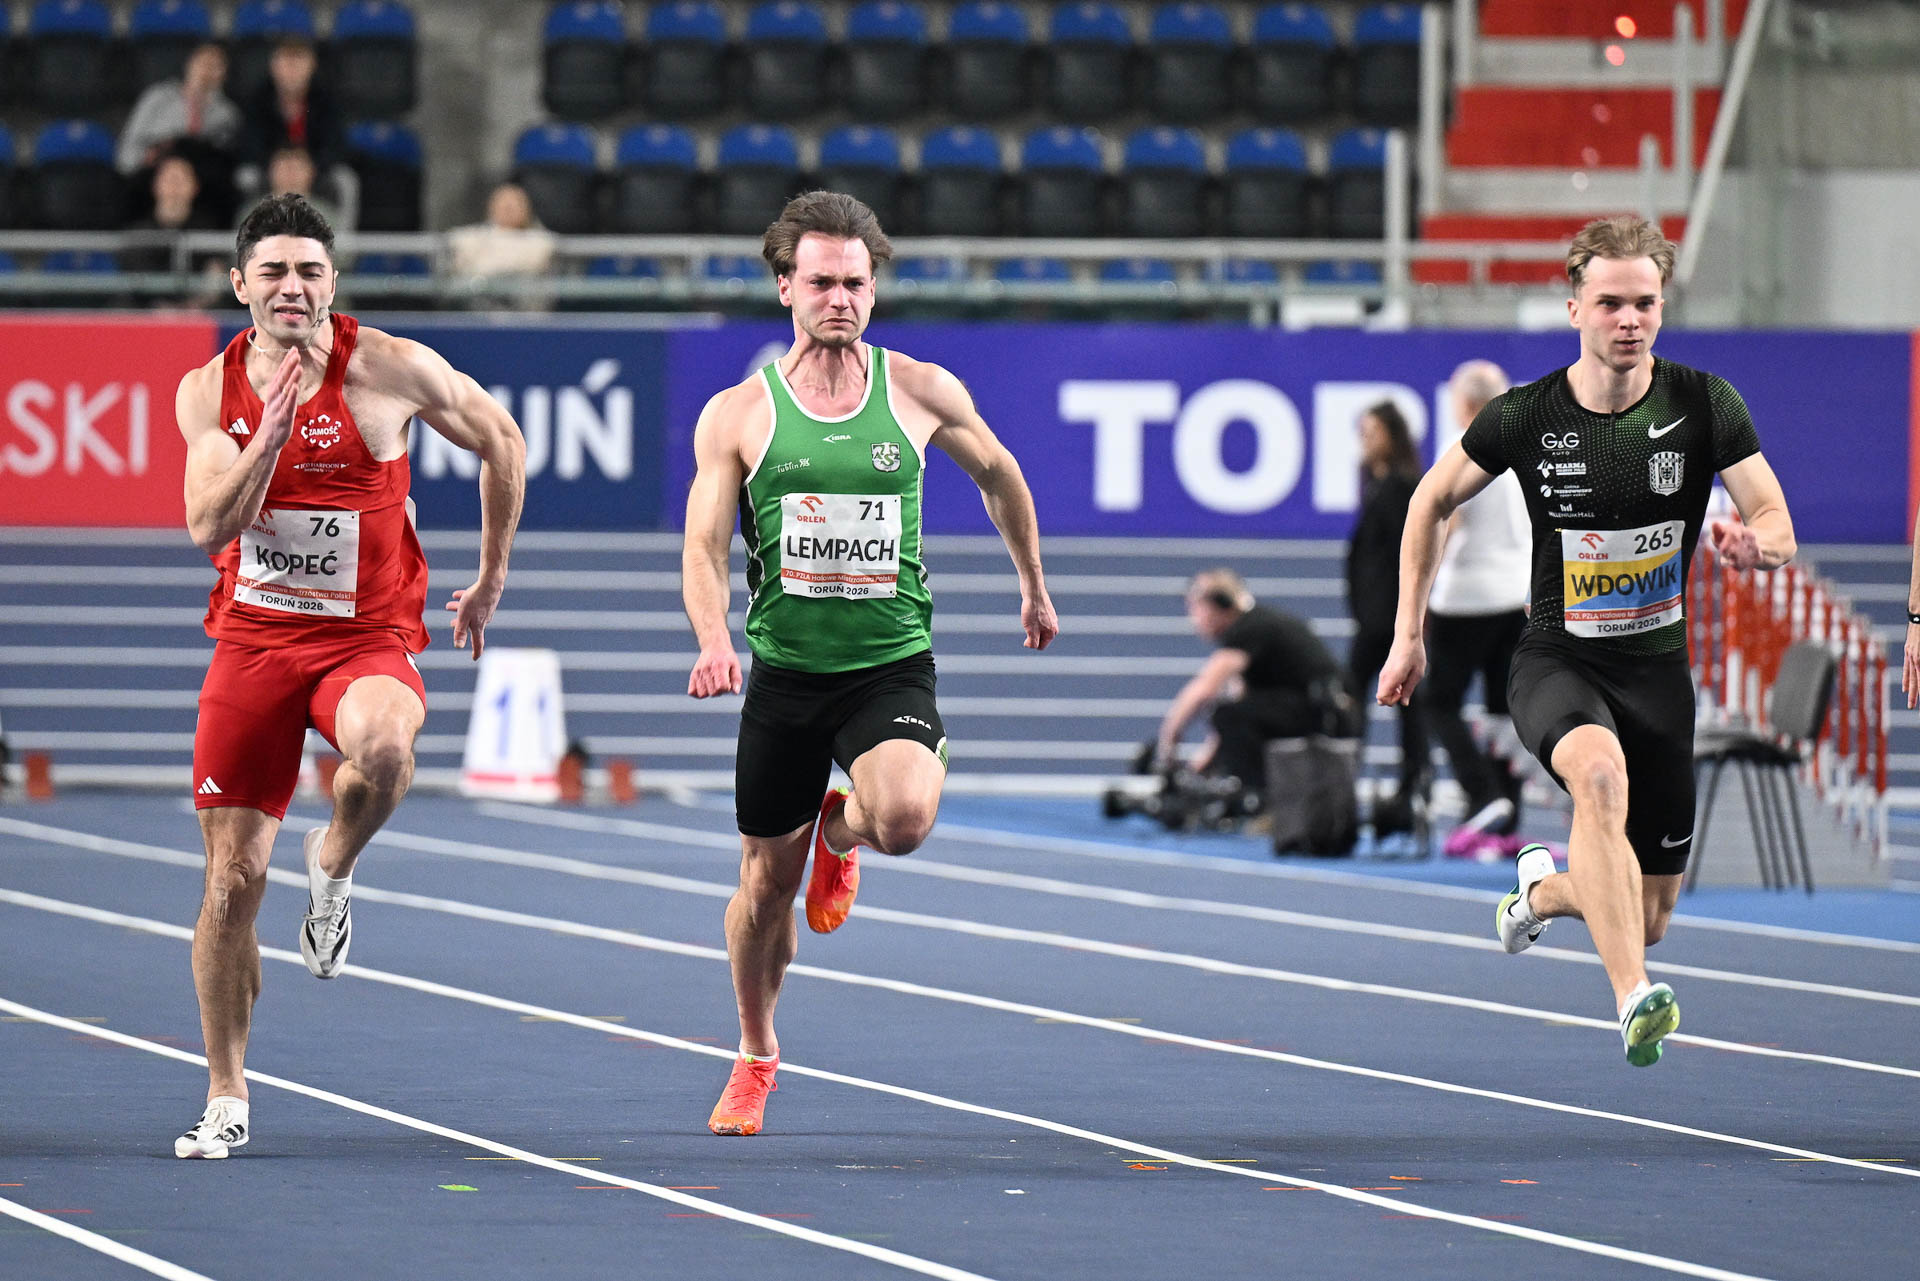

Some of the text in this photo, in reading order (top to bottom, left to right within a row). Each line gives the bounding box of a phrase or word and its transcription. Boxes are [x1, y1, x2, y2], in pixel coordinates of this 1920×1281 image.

[1, 378, 150, 477] SKI
[309, 425, 339, 436] ZAMOŚĆ
[1058, 377, 1465, 515] TOR
[1541, 432, 1580, 449] G&G
[797, 514, 826, 523] ORLEN
[859, 501, 885, 521] 71
[251, 524, 276, 537] ORLEN
[310, 517, 340, 538] 76
[786, 535, 895, 562] LEMPACH
[1634, 526, 1673, 555] 265
[255, 545, 338, 576] KOPEĆ
[1578, 552, 1609, 560] ORLEN
[796, 572, 811, 581] PZLA
[838, 574, 875, 584] Mistrzostwa
[1570, 562, 1677, 597] WDOWIK
[330, 591, 351, 600] Polski
[808, 583, 869, 596] TORUŃ 2026
[259, 594, 324, 611] TORUŃ 2026
[1582, 611, 1599, 619] PZLA
[1596, 616, 1661, 633] TORUŃ 2026
